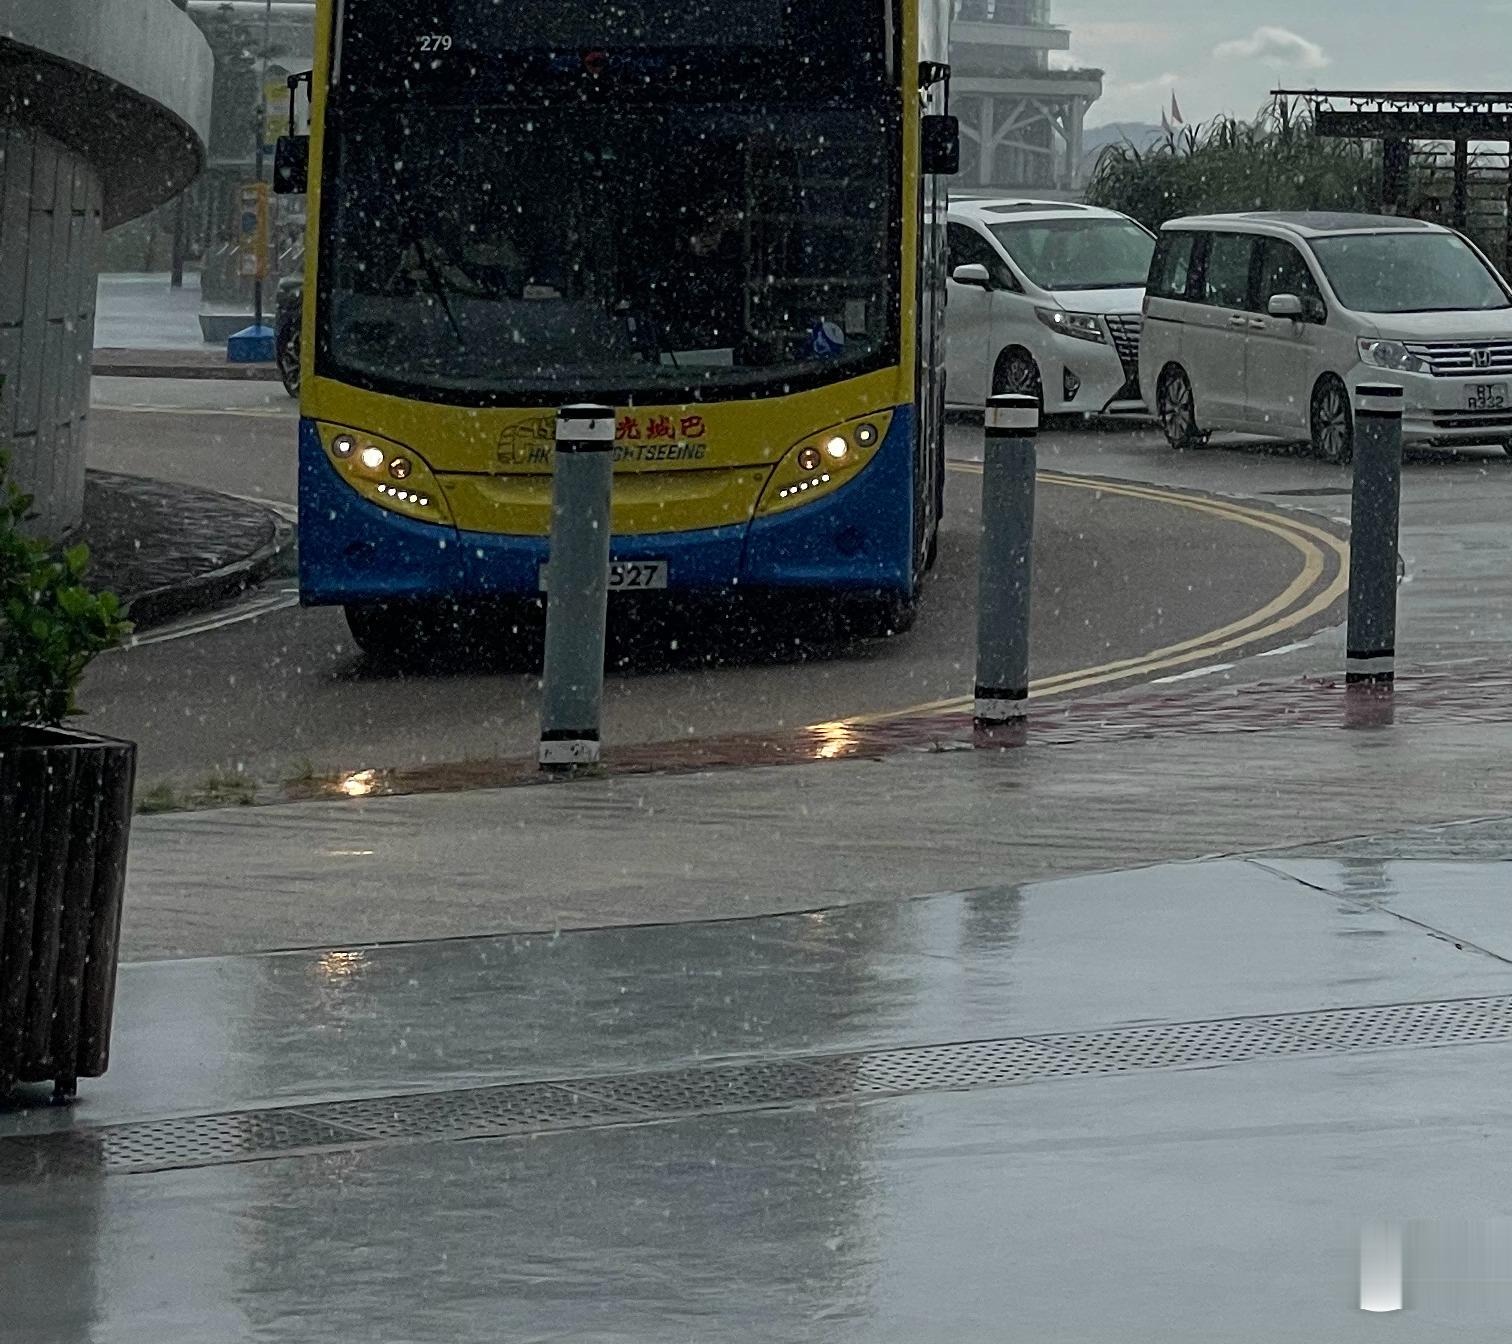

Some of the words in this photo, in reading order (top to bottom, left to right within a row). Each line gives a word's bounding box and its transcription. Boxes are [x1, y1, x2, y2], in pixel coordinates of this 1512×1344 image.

[420, 35, 453, 52] 279
[613, 414, 706, 440] 光城巴
